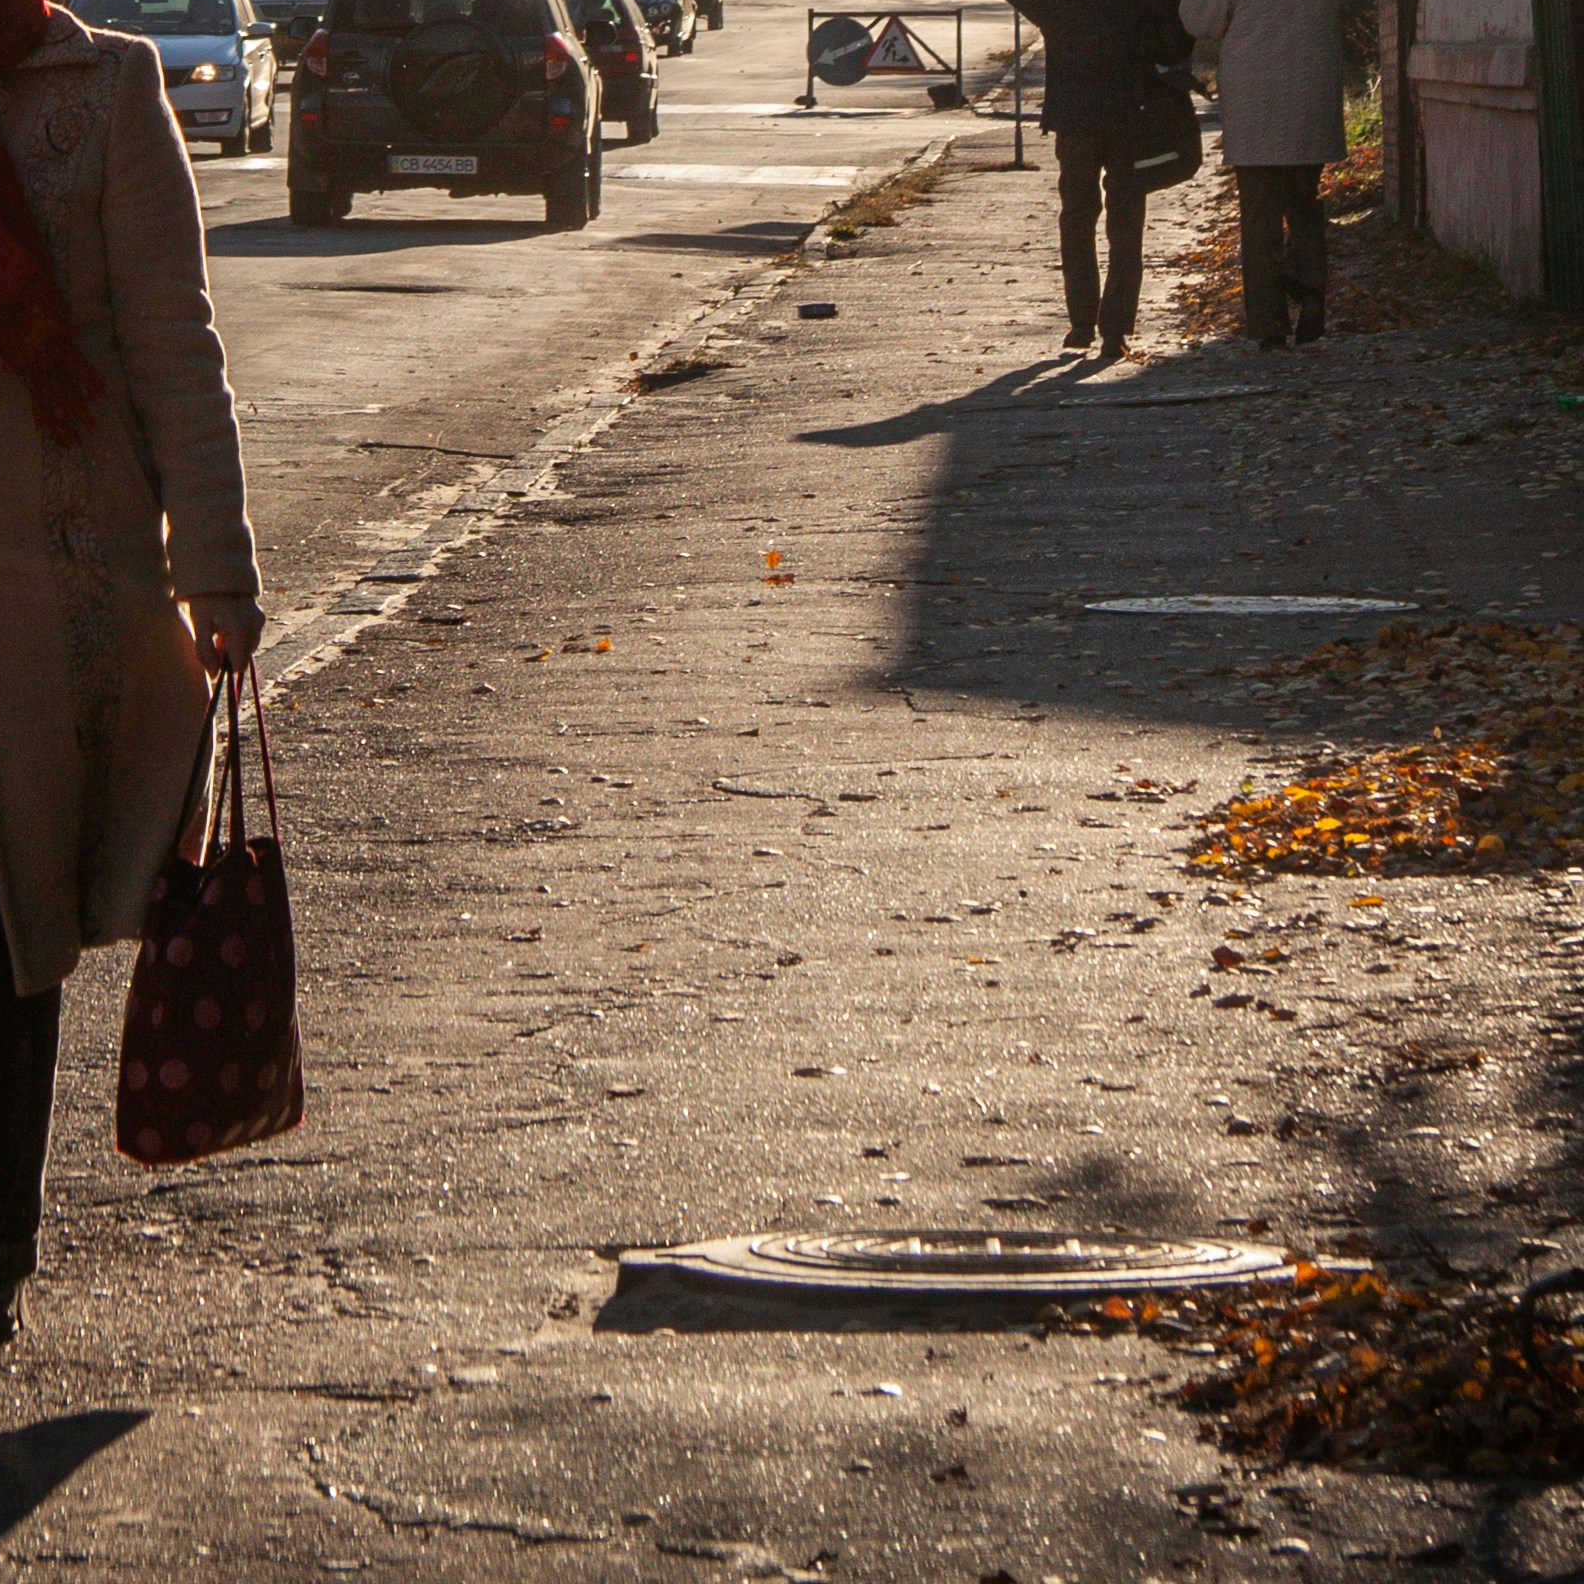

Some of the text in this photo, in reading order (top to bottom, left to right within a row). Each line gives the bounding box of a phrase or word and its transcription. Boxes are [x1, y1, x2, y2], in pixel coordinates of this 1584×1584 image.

[400, 158, 474, 172] CB 4454 BB
